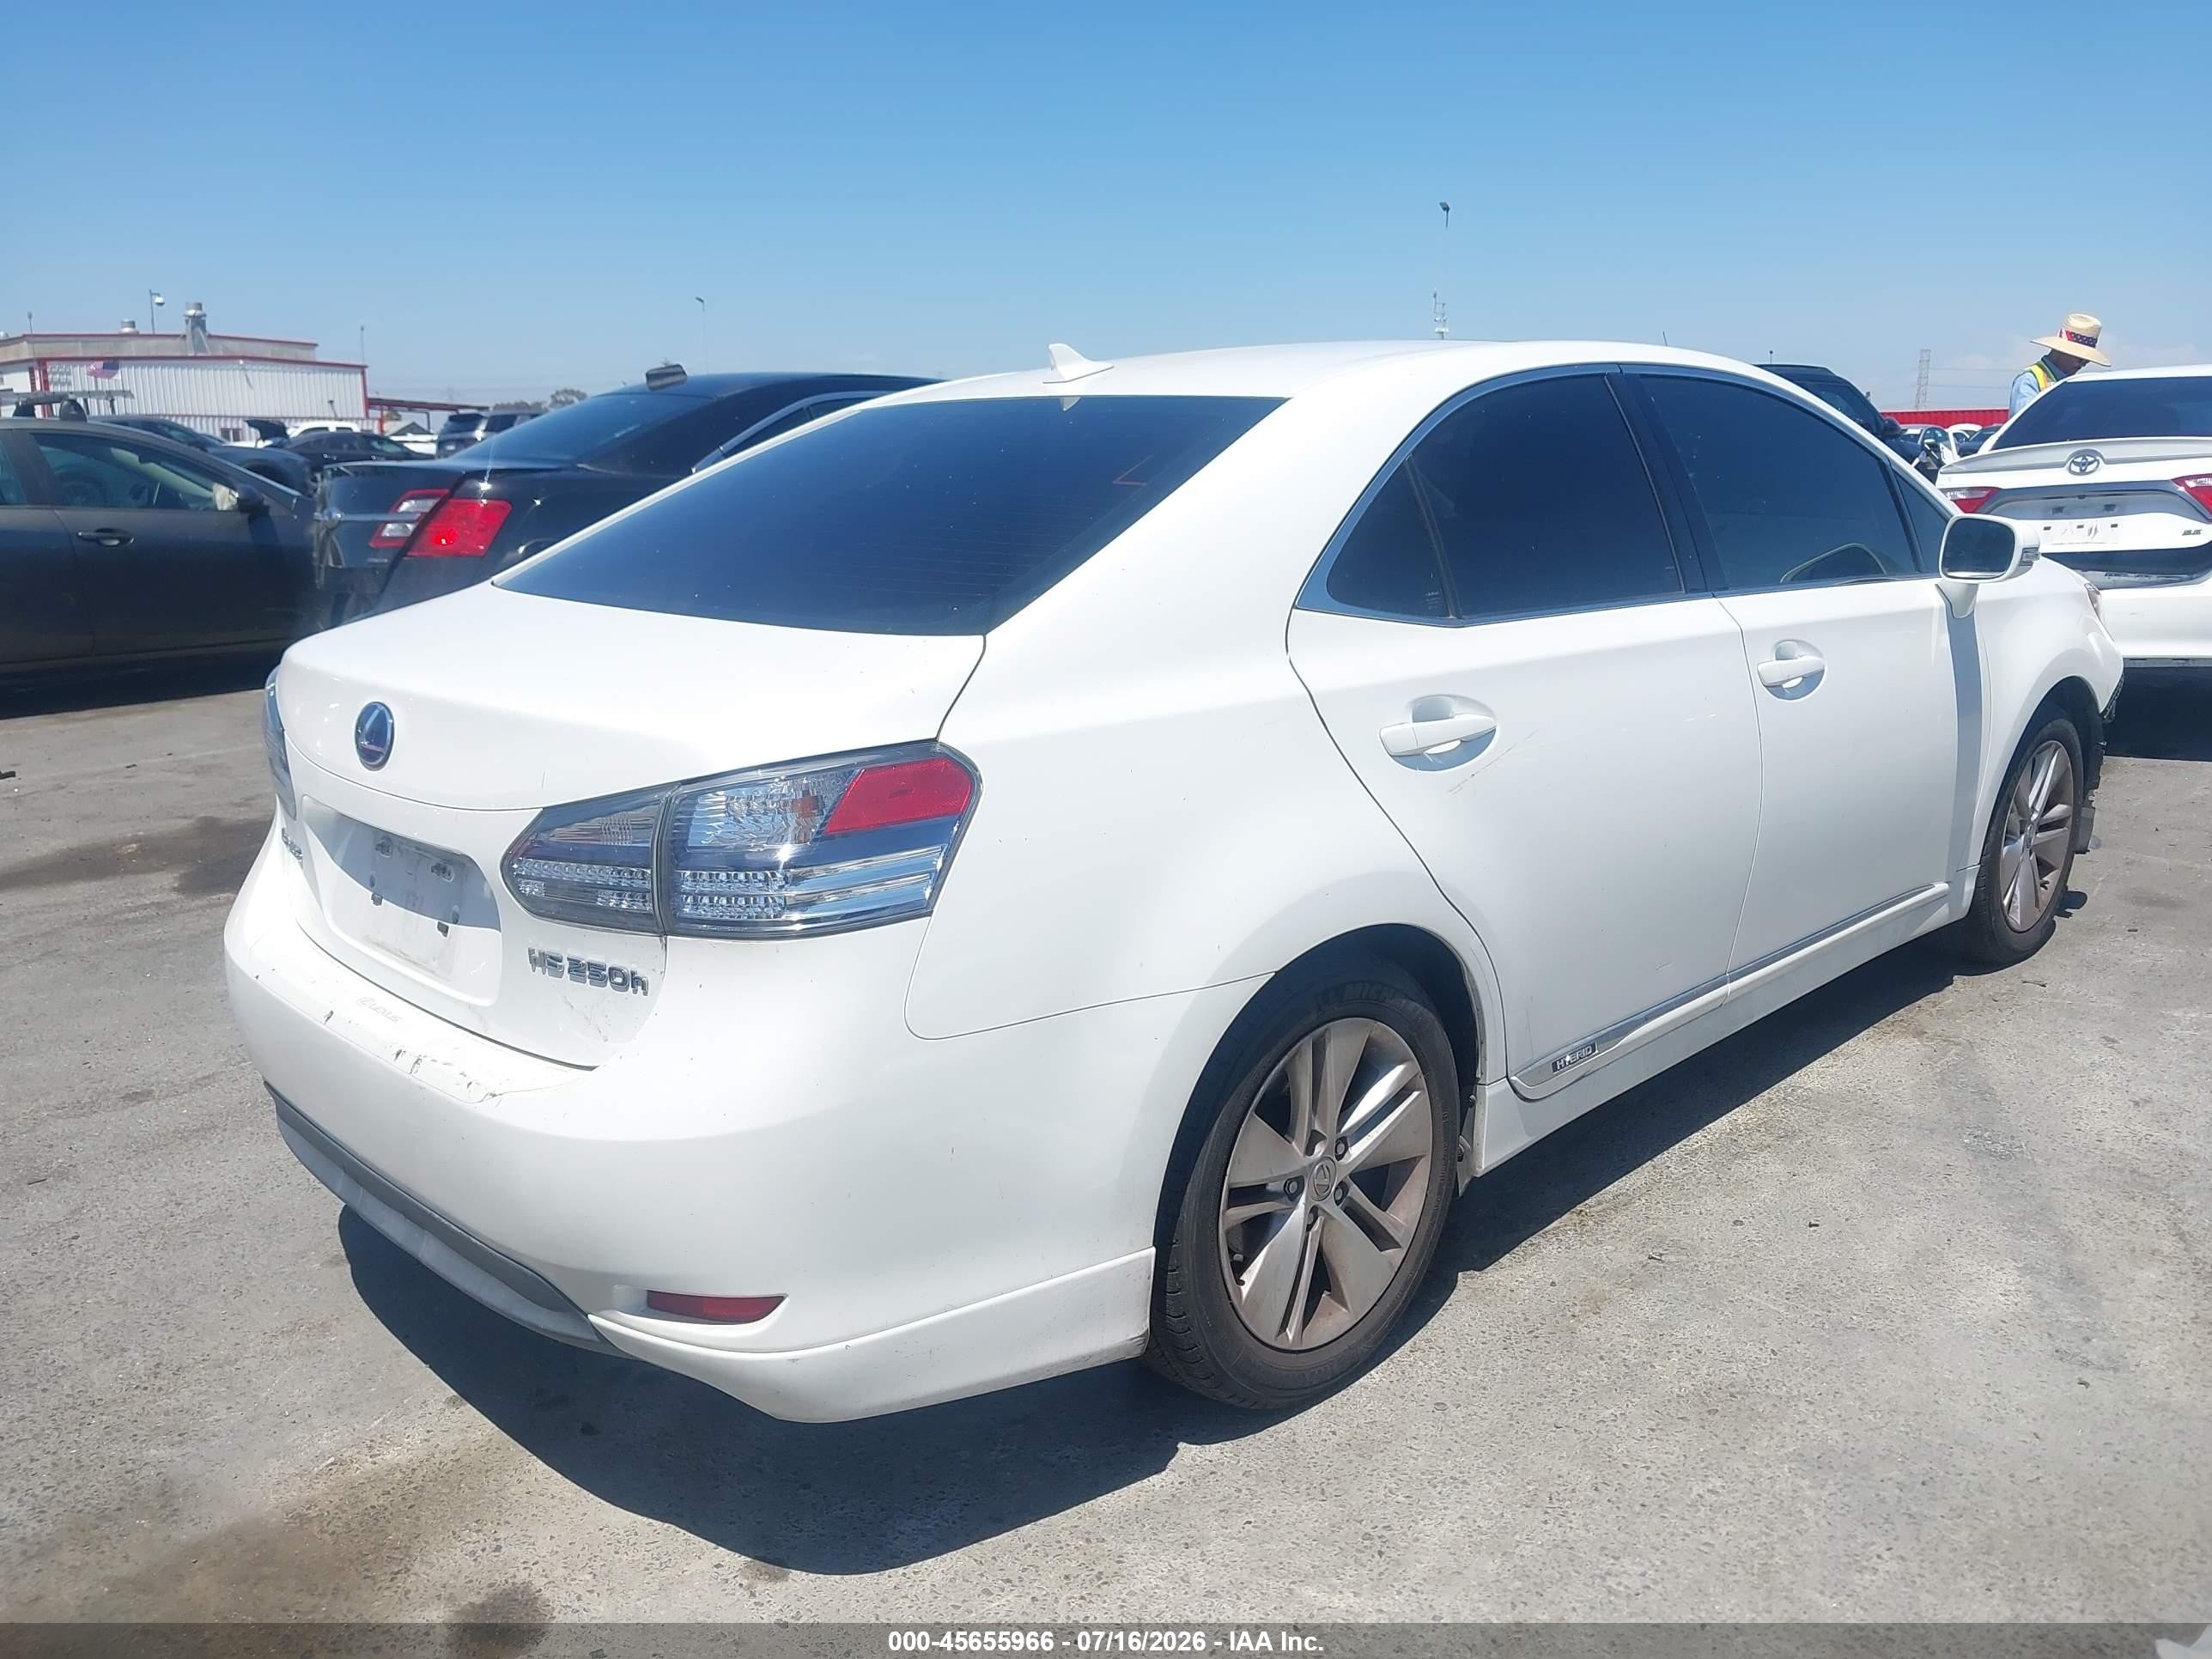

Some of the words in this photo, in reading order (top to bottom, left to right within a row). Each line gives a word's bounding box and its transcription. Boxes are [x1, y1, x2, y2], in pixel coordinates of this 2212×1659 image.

[527, 947, 564, 978] HS
[567, 955, 649, 996] 250h
[1556, 1045, 1593, 1070] HYBRID
